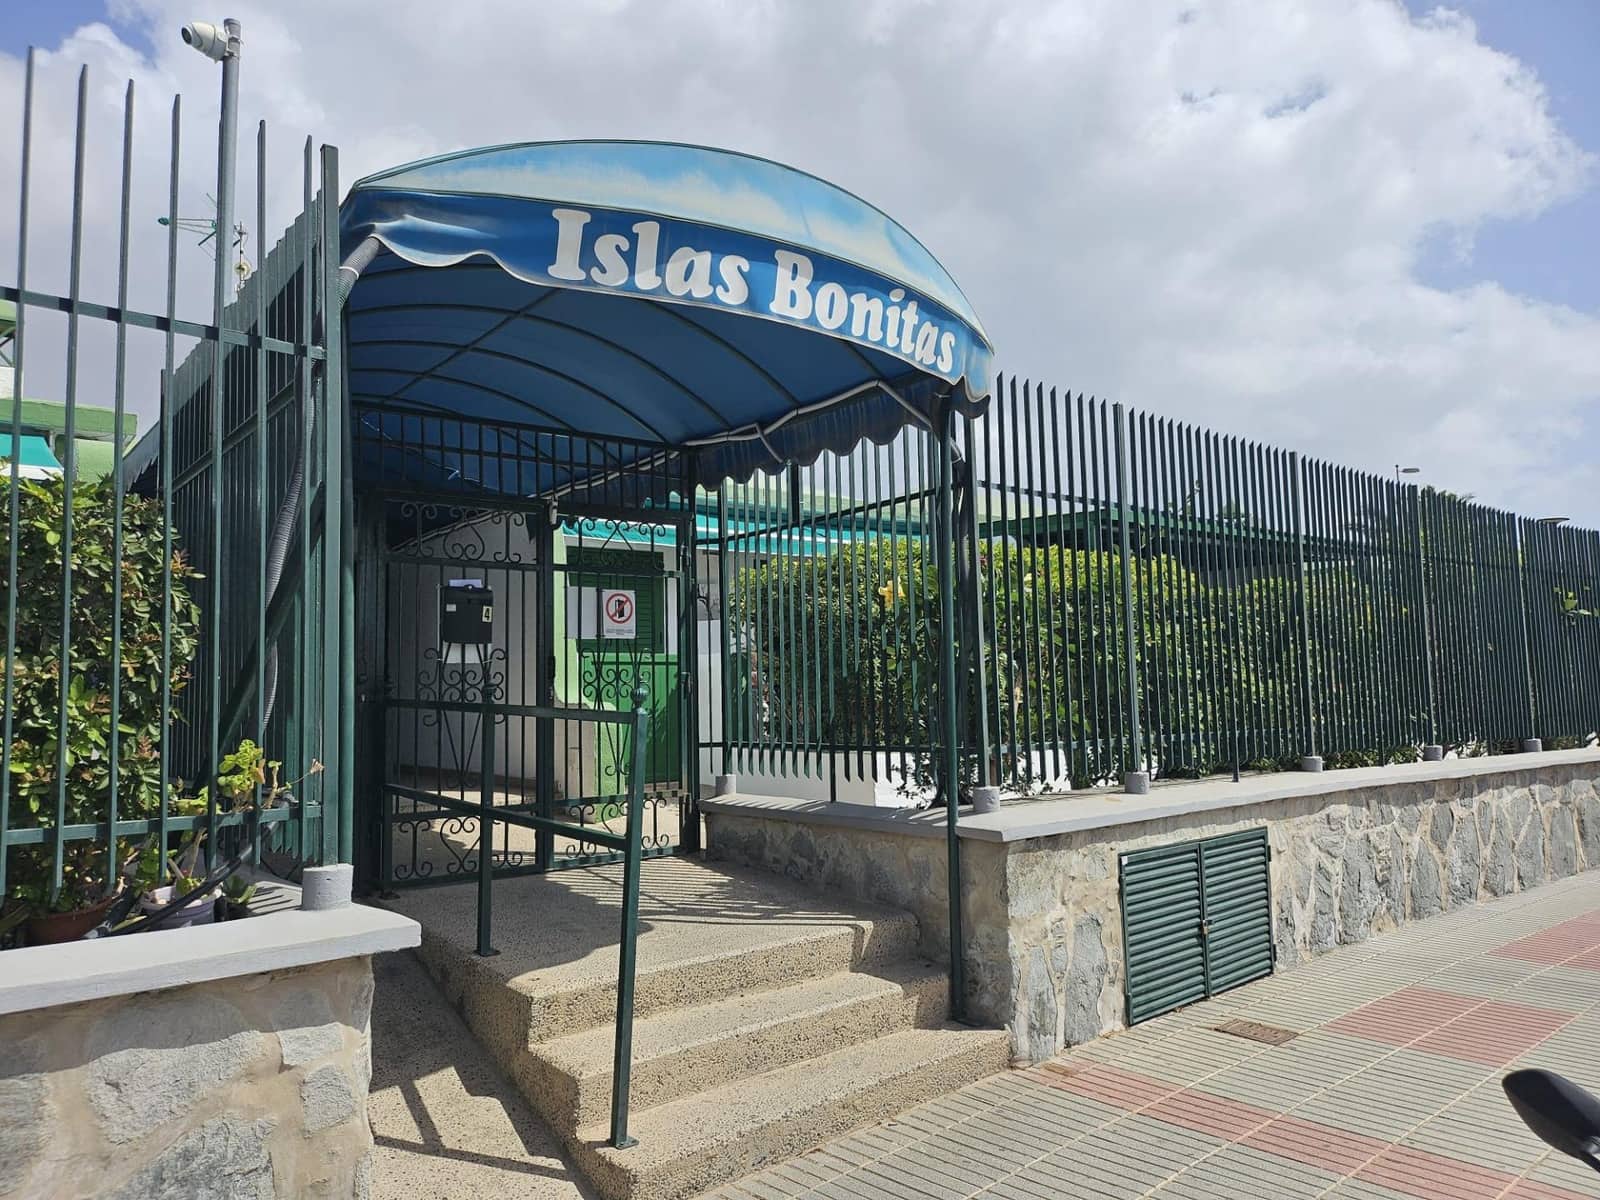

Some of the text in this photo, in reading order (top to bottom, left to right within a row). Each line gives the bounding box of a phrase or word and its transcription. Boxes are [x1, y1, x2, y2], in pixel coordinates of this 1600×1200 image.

[547, 208, 957, 373] Islas Bonitas
[484, 607, 490, 621] 4
